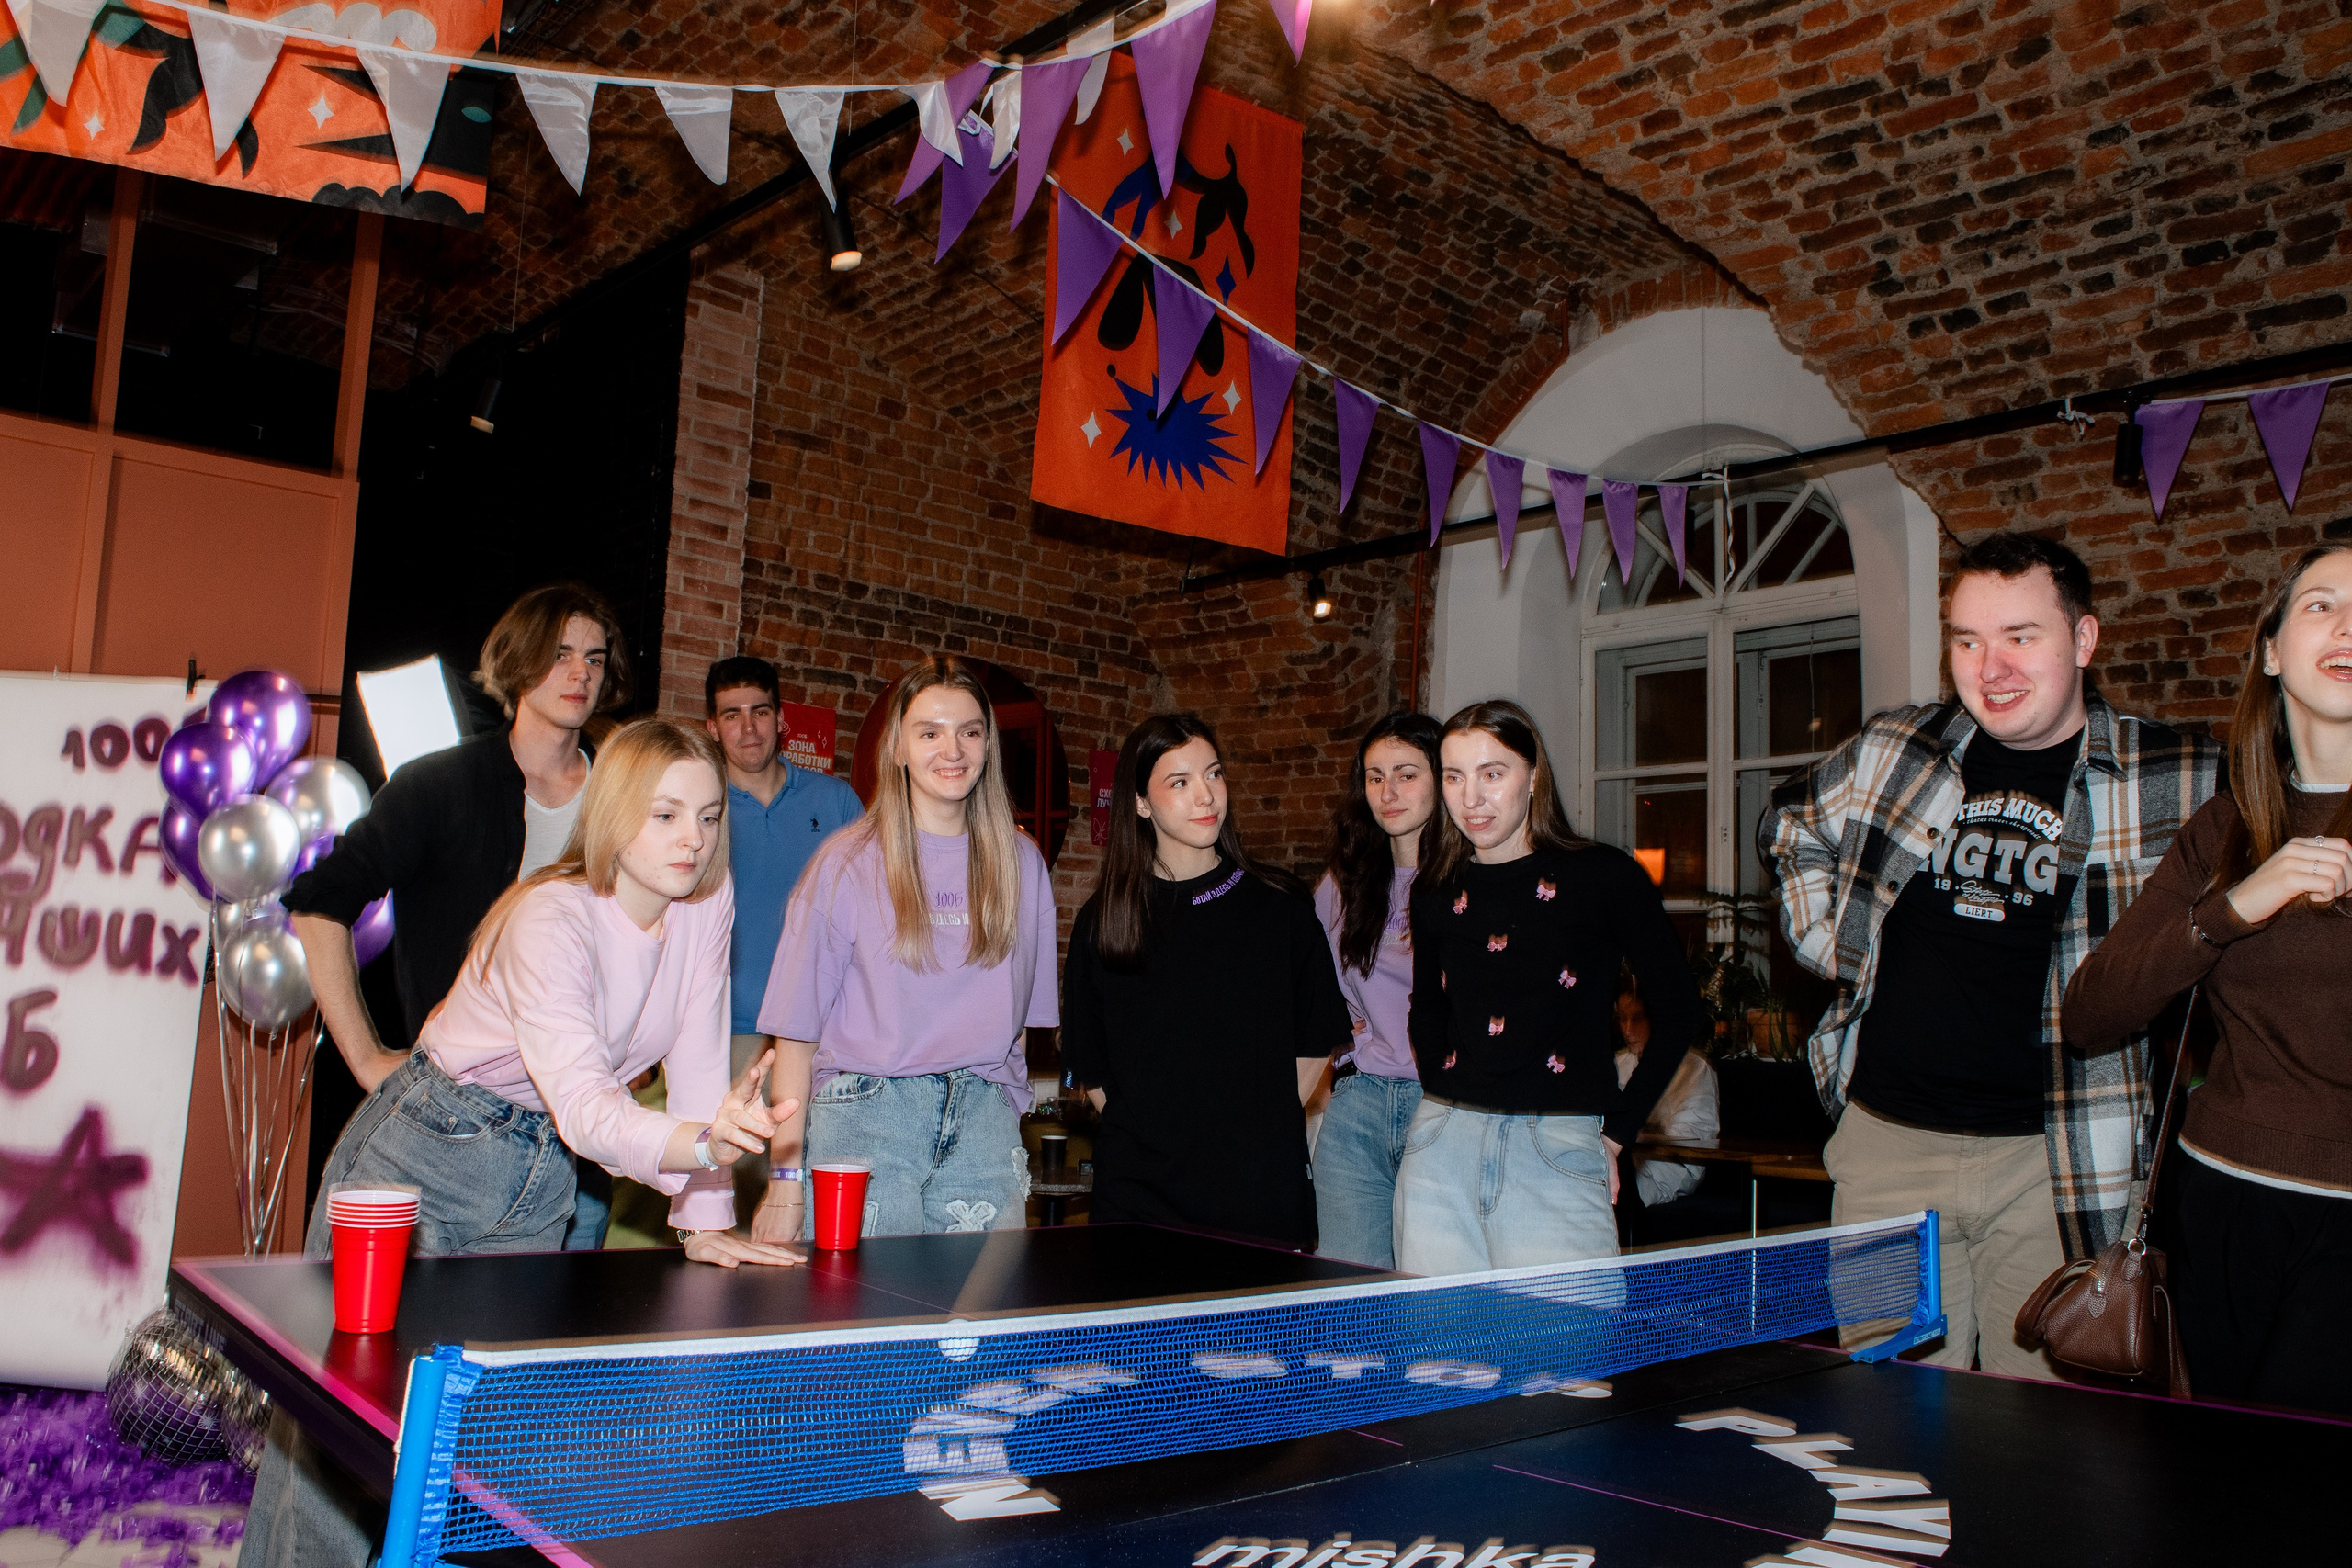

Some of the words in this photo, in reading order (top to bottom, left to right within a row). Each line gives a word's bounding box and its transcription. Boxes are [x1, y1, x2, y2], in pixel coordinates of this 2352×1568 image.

[61, 709, 207, 773] 100
[788, 739, 816, 753] ЗОНА
[1957, 797, 2005, 821] THIS
[2002, 798, 2063, 842] MUCH
[1192, 890, 1213, 906] БОТАЙ
[1211, 882, 1232, 898] ЗДЕСЬ
[1934, 878, 1951, 891] 19
[2012, 891, 2034, 907] 96
[928, 912, 961, 928] ЗДЕСЬ
[1385, 916, 1408, 931] 100
[1965, 906, 1993, 919] LIERT
[1192, 1540, 1597, 1568] mishka
